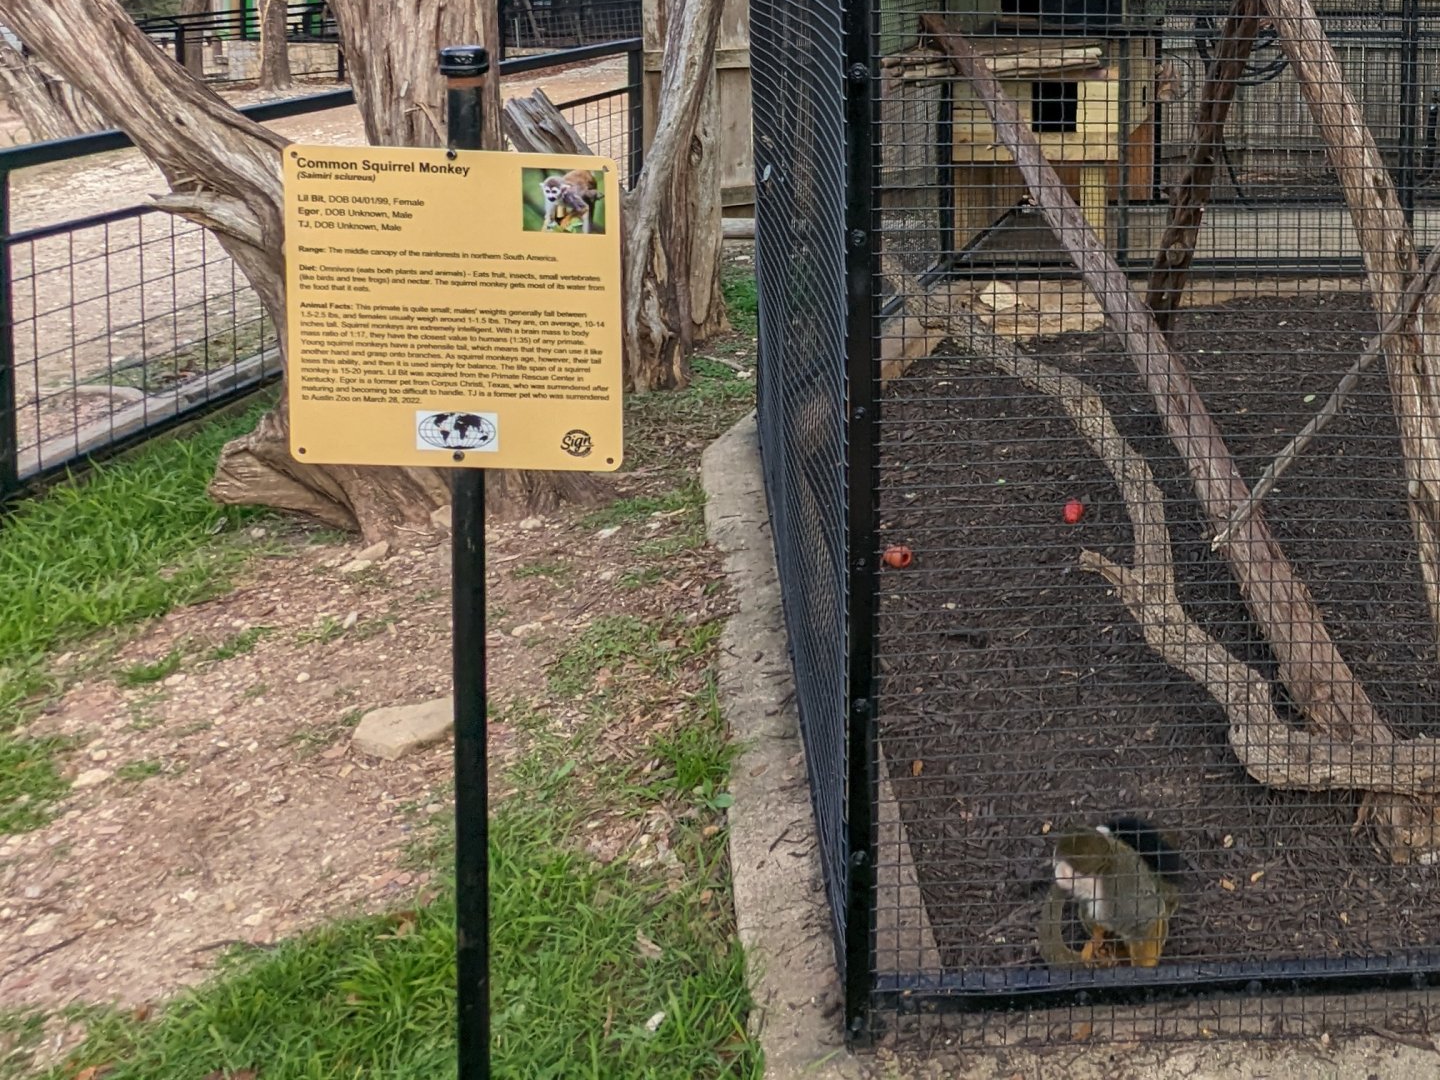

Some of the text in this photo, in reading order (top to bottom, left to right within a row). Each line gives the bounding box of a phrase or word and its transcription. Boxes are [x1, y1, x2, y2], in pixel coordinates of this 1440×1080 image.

[297, 157, 470, 178] Common Squirrel Monkey
[334, 173, 376, 182] sciureus)
[297, 194, 309, 202] Lil
[328, 195, 349, 203] DOB
[351, 196, 391, 205] 04/01/99,
[393, 198, 425, 207] Female
[325, 208, 345, 216] DOB
[348, 209, 390, 219] Unknown,
[392, 211, 413, 219] Male
[298, 220, 402, 232] TJ, DOB Unknown, Male
[560, 435, 592, 452] Sign
